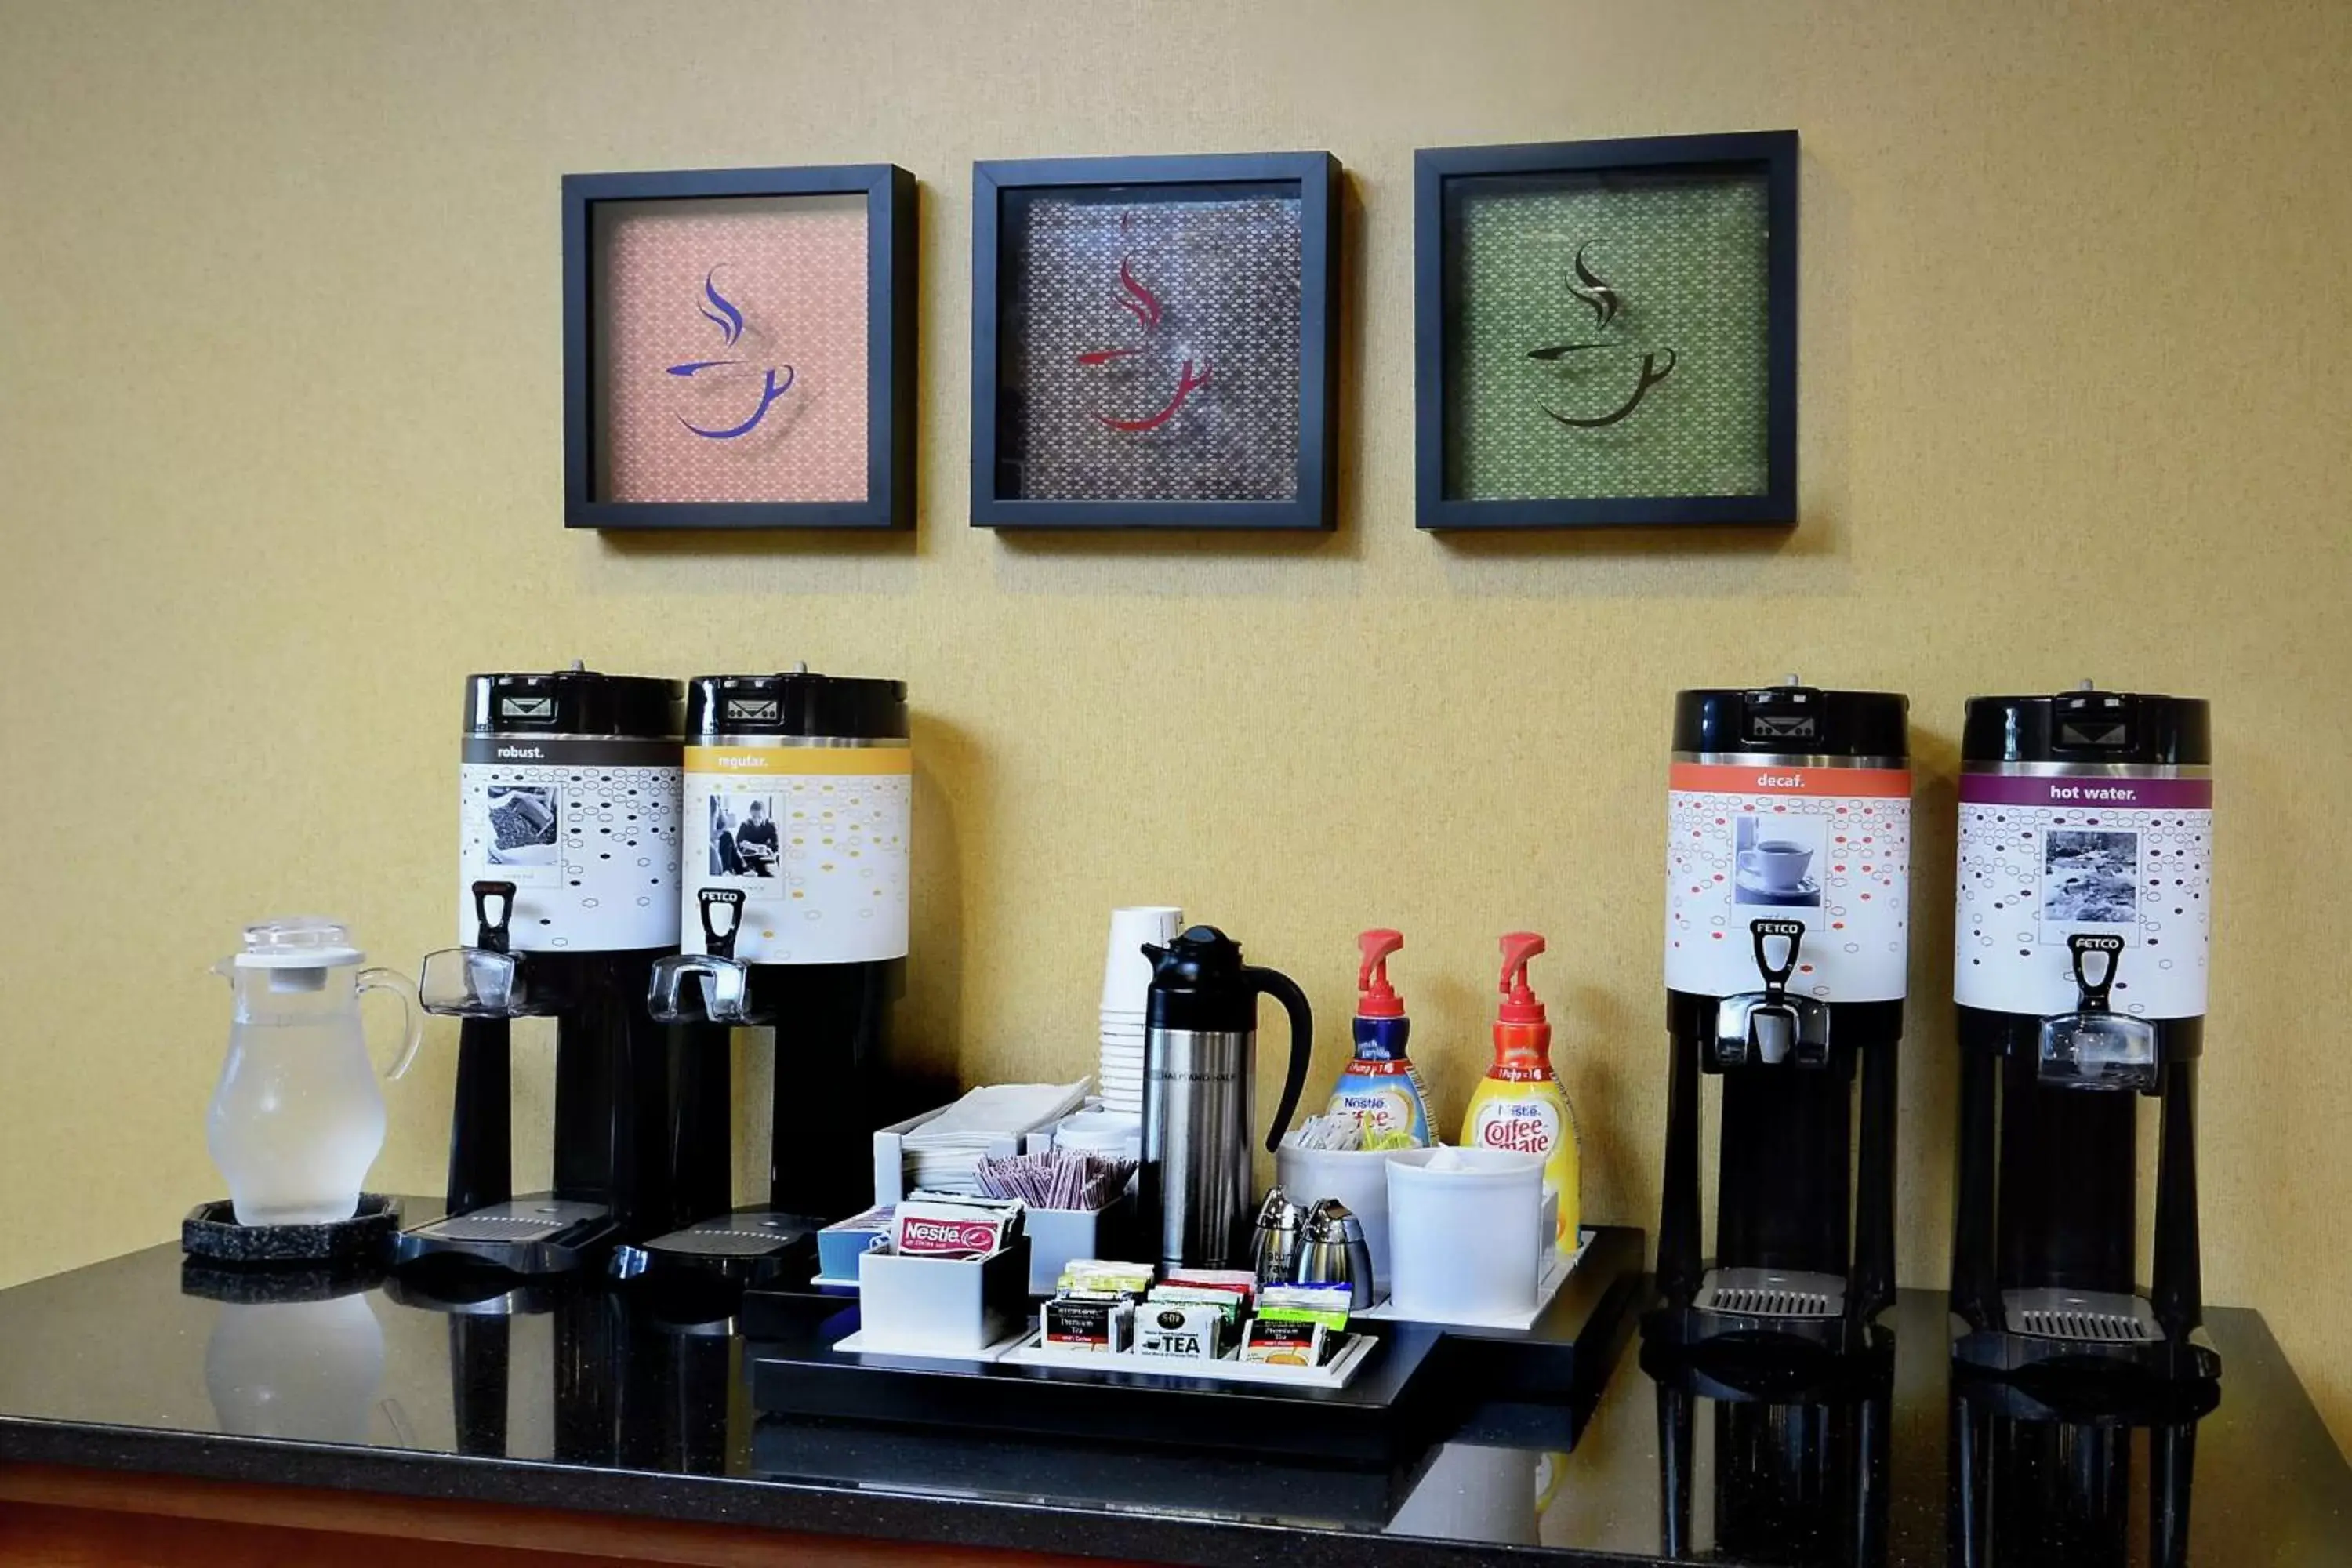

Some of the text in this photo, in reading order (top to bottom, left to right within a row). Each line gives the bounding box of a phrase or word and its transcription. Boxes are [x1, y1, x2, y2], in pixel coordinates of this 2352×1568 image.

[497, 745, 545, 758] robust.
[1757, 772, 1806, 788] decaf.
[2050, 785, 2136, 800] hot water.
[702, 891, 738, 902] FETCO
[1757, 923, 1798, 934] FETCO
[2075, 938, 2119, 949] FETCO
[1163, 1336, 1200, 1354] TEA
